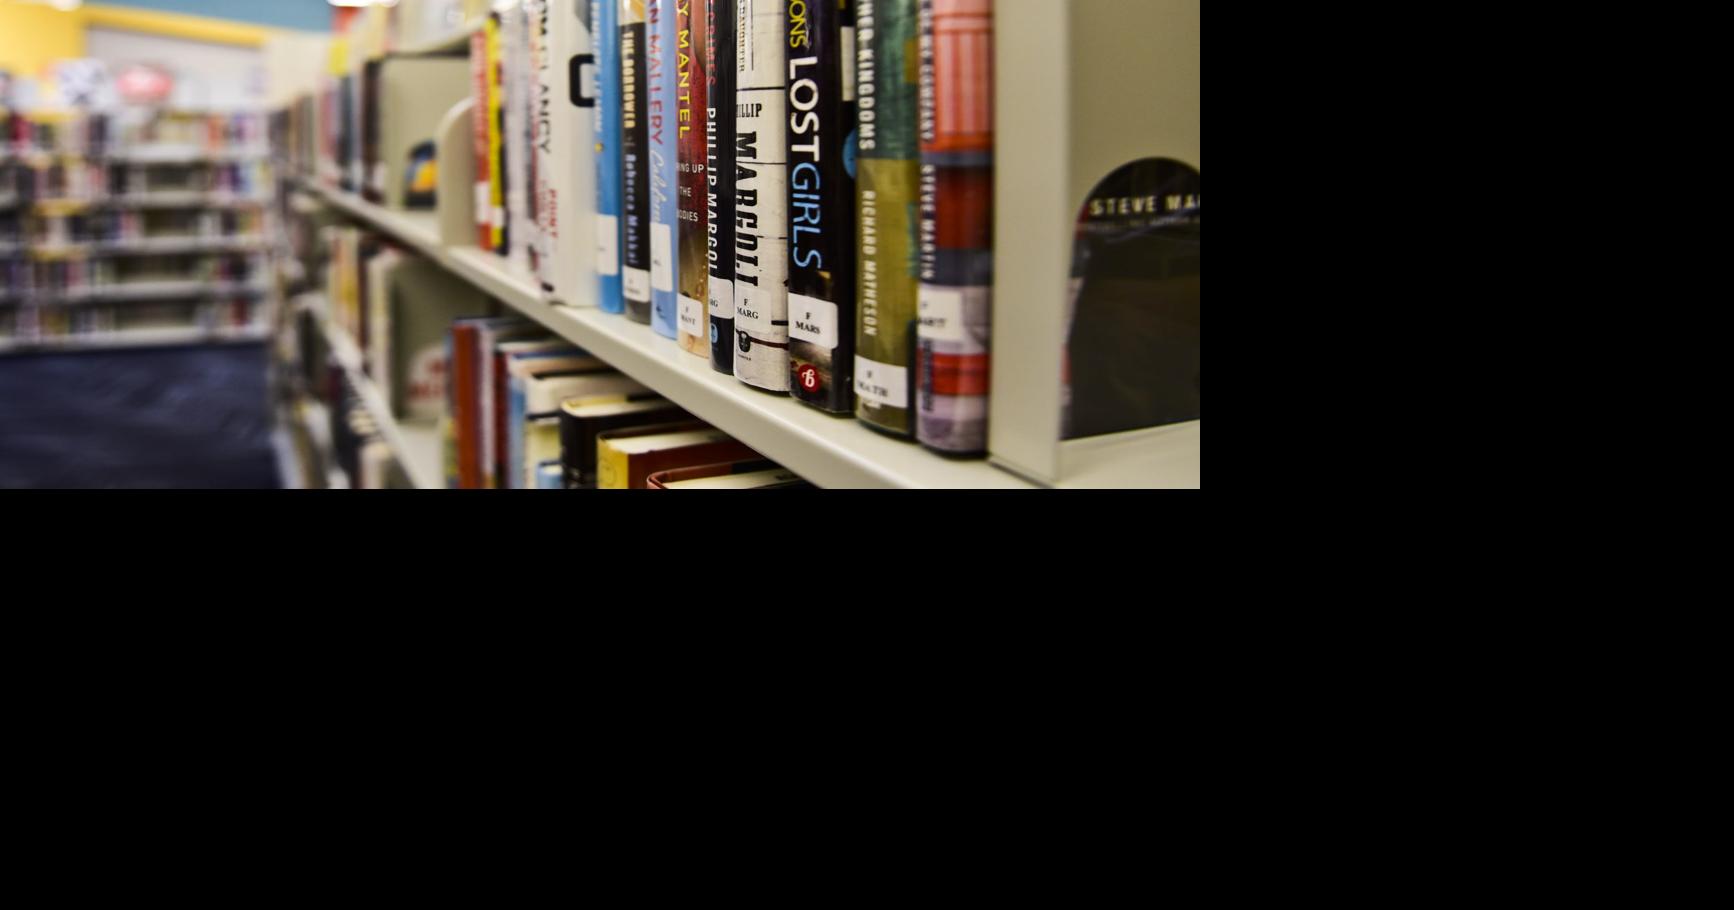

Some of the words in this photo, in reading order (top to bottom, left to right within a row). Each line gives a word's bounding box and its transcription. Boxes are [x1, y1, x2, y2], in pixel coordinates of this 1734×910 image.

[622, 31, 634, 56] THE
[622, 59, 635, 128] BORROWER
[649, 34, 663, 145] MALLERY
[678, 29, 690, 139] MANTEL
[789, 56, 819, 161] LOST
[858, 48, 876, 150] KINGDOMS
[692, 164, 704, 173] UP
[706, 107, 717, 186] PHILLIP
[625, 154, 636, 211] Rebecca
[679, 186, 692, 197] THE
[920, 163, 937, 212] STEVE
[1088, 195, 1157, 217] STEVE
[1165, 192, 1200, 210] MA
[627, 215, 638, 264] Makkai
[792, 162, 821, 269] GIRLS
[862, 190, 877, 255] RICHARD
[920, 218, 937, 280] MARTIN
[736, 306, 759, 319] MARG
[743, 298, 749, 306] F
[805, 312, 811, 320] F
[863, 259, 878, 336] MATHESON
[795, 320, 821, 335] MARS
